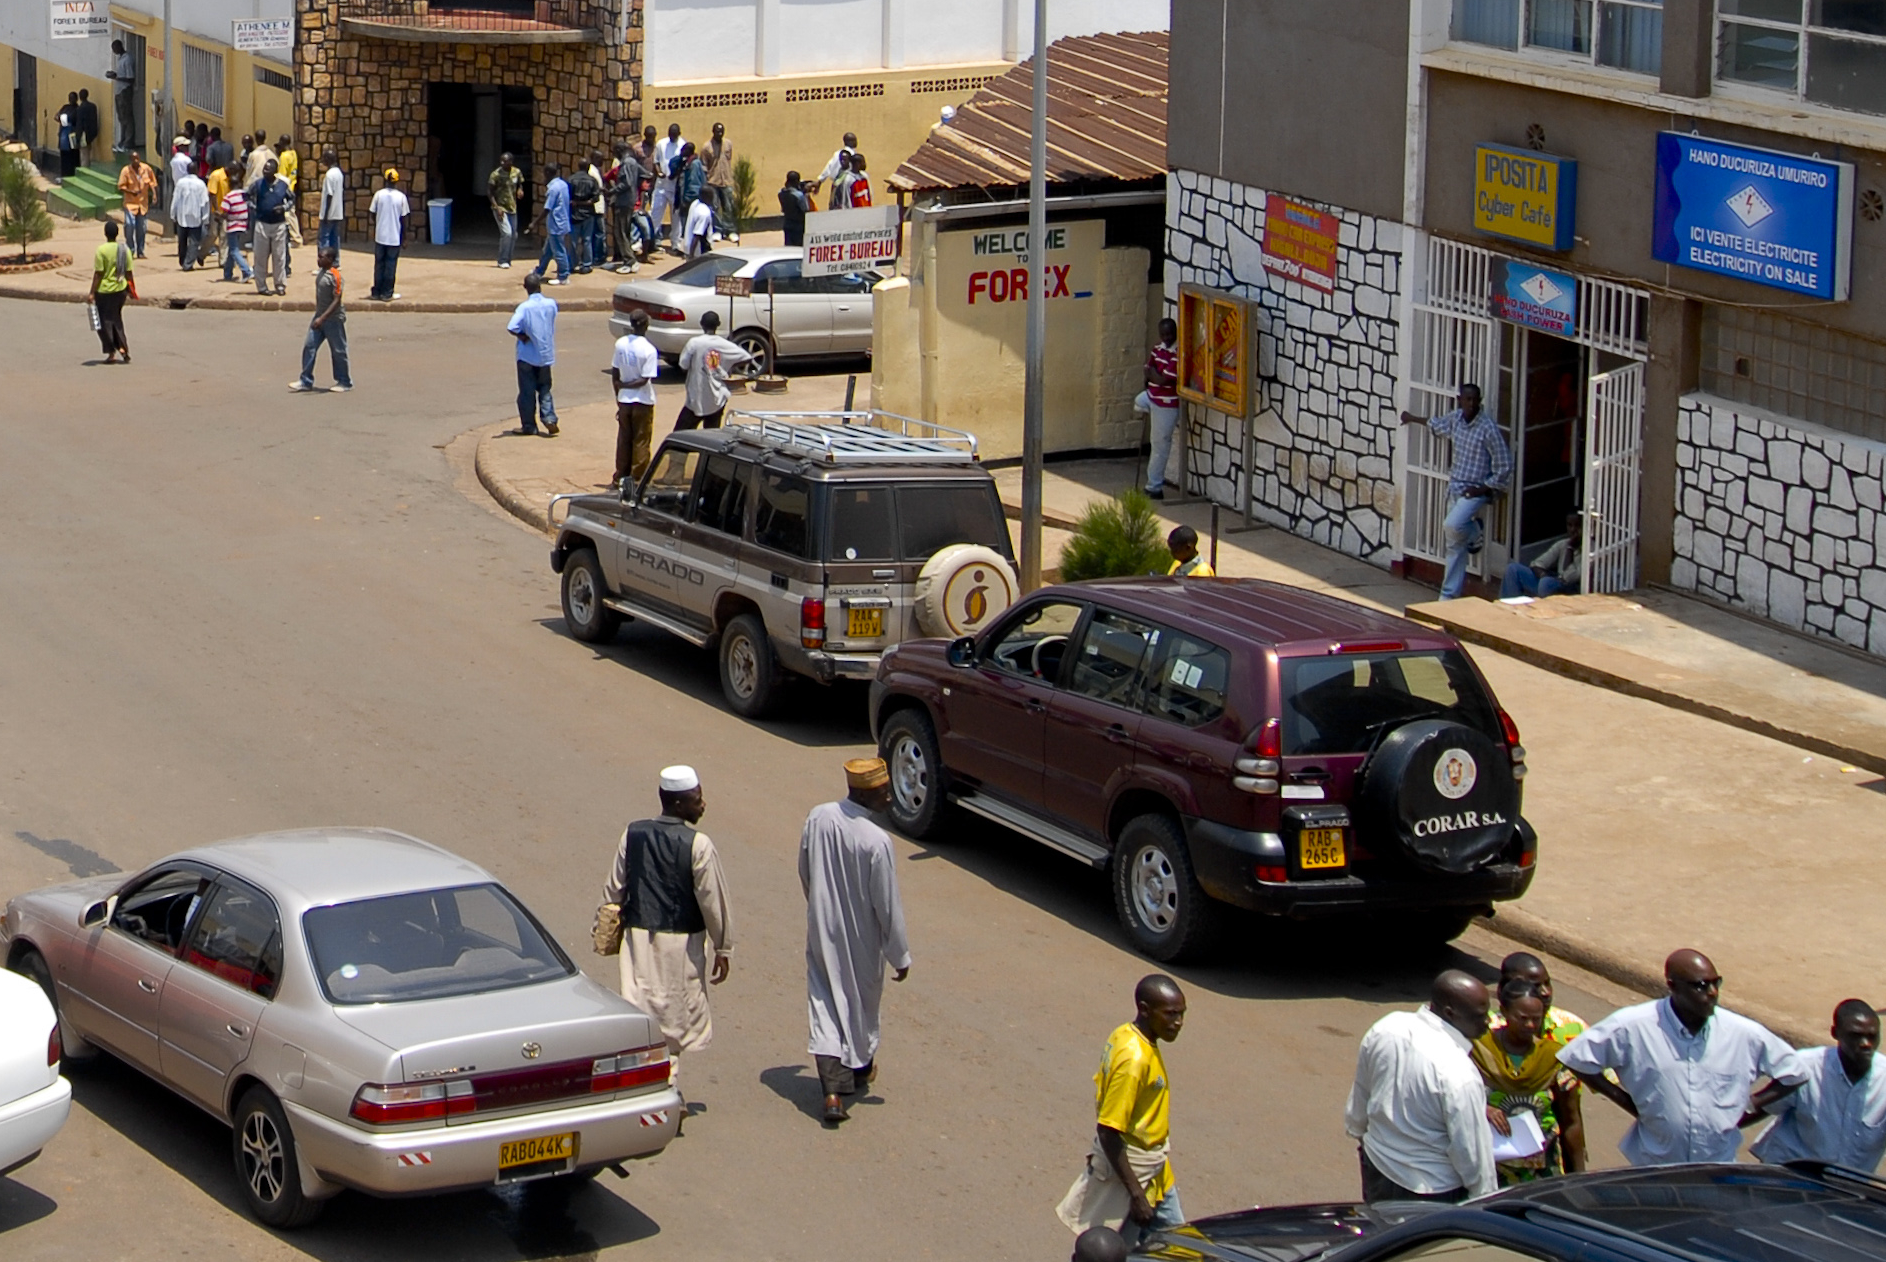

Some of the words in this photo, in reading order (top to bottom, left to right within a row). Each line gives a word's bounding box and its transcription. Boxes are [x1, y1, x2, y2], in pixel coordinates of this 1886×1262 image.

[65, 1, 95, 13] INEZA
[79, 16, 108, 25] BUREAU
[237, 21, 281, 31] ATHENEE
[1485, 153, 1548, 194] IPOSITA
[1689, 148, 1719, 166] HANO
[1720, 154, 1776, 177] DUCURUZA
[1778, 165, 1828, 188] UMURIRO
[1478, 190, 1516, 222] Cyber
[808, 239, 894, 264] FOREX-BUREAU
[1690, 226, 1705, 241] ICI
[1706, 229, 1742, 251] VENTE
[1744, 236, 1818, 267] ELECTRICITE
[1016, 254, 1029, 264] TO
[1690, 247, 1763, 276] ELECTRICITY
[1765, 264, 1783, 282] ON
[1785, 268, 1818, 289] SALE
[1519, 300, 1572, 322] DUCURUZA
[1526, 312, 1564, 332] POWER
[626, 547, 705, 585] PRADO
[854, 609, 873, 621] RAA
[1414, 811, 1480, 837] CORAR
[1307, 831, 1332, 847] RAB
